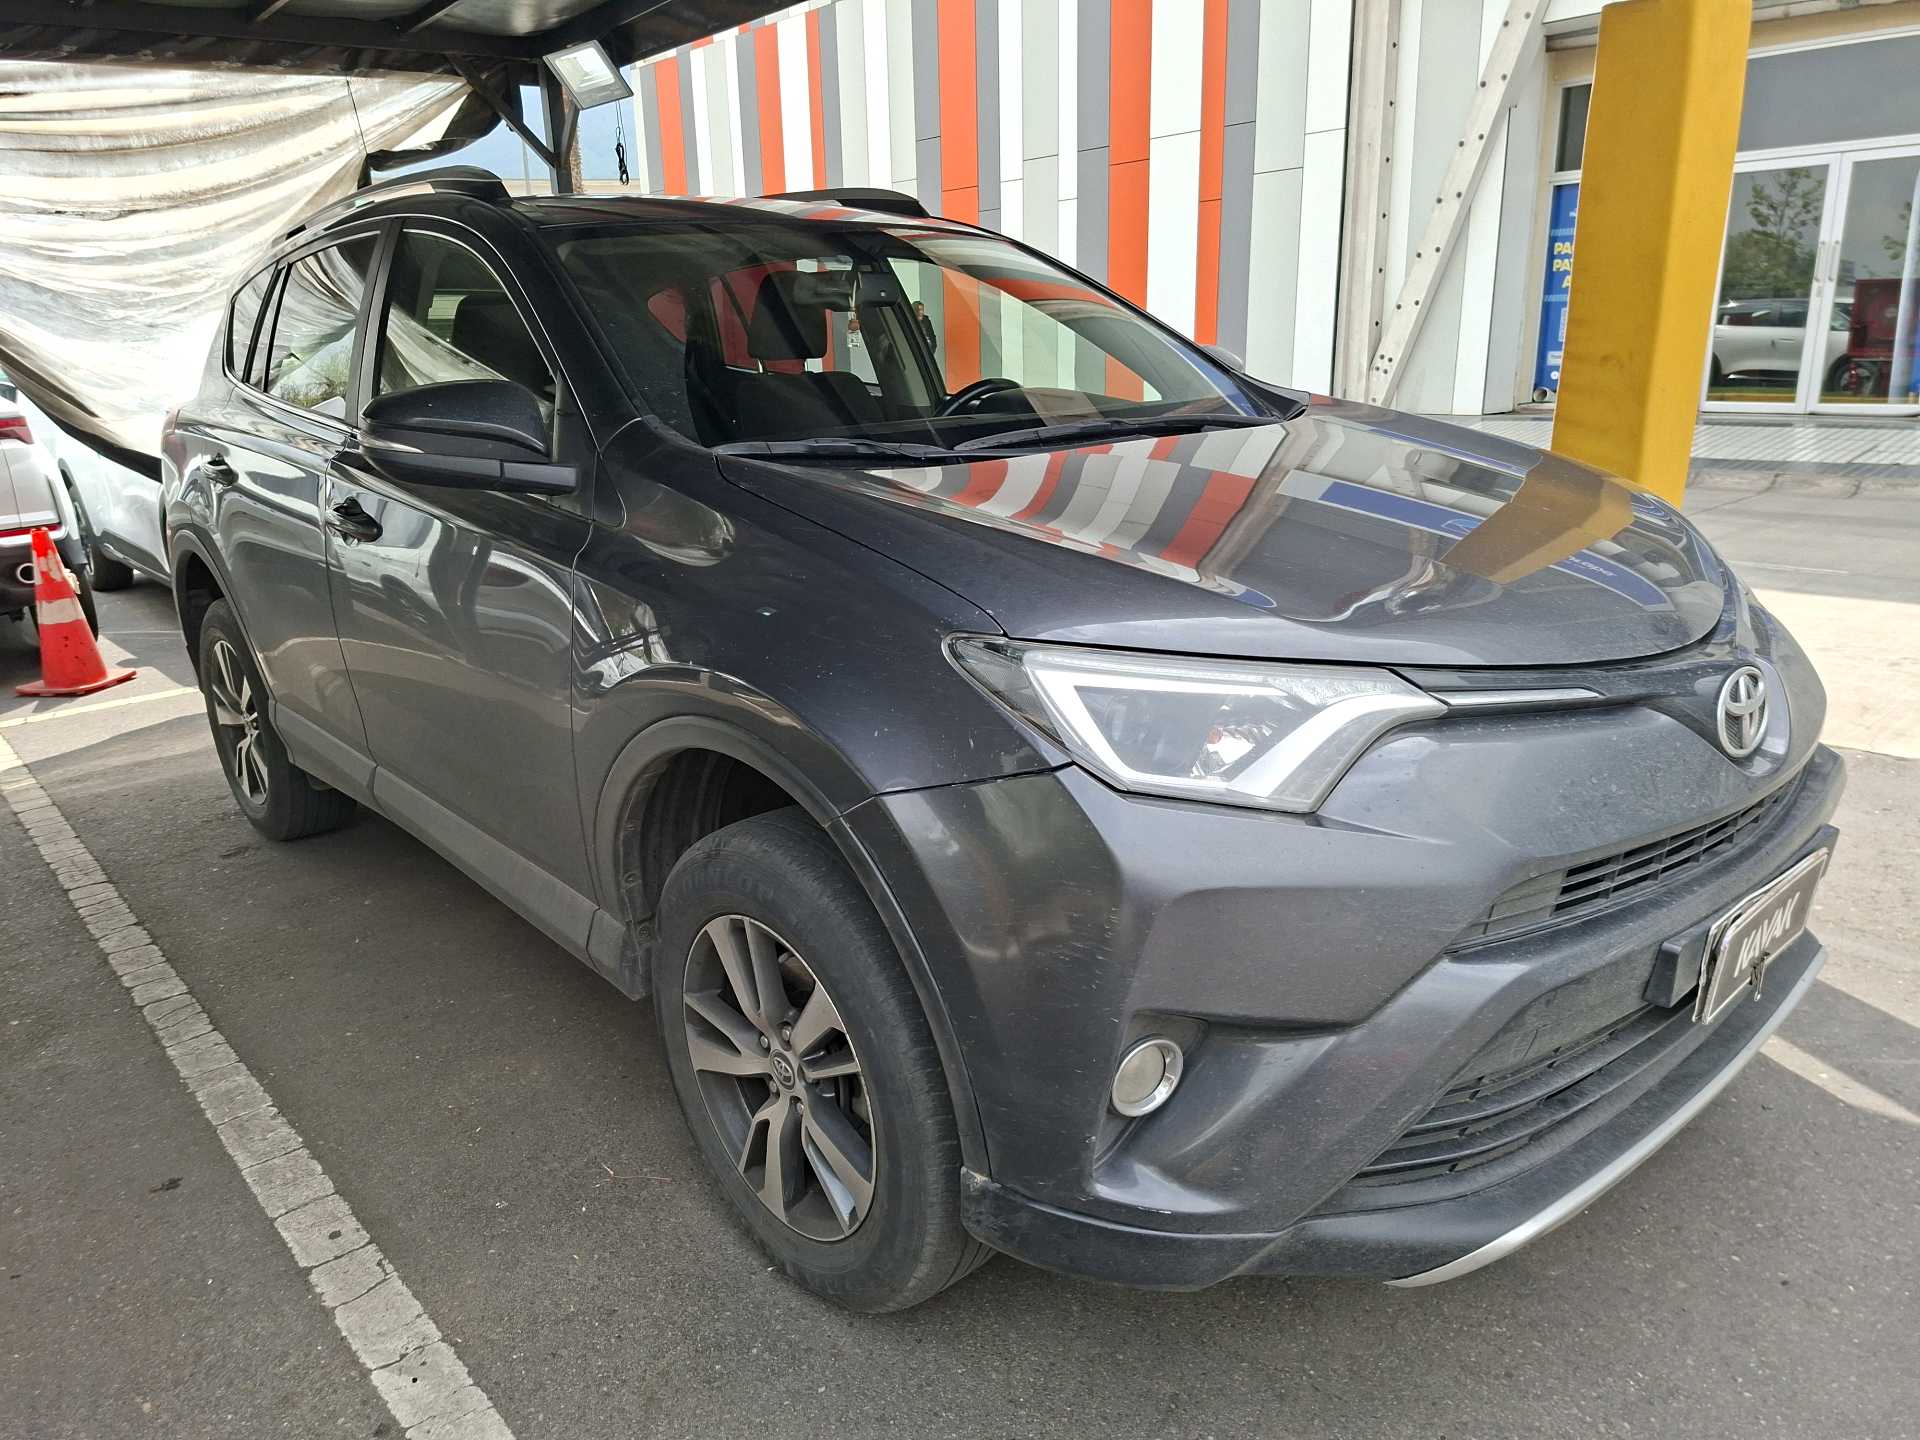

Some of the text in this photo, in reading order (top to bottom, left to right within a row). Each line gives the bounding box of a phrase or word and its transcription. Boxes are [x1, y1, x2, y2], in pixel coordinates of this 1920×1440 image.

[1553, 241, 1572, 255] PA
[1552, 257, 1572, 271] PA
[1733, 890, 1801, 978] KAVAK
